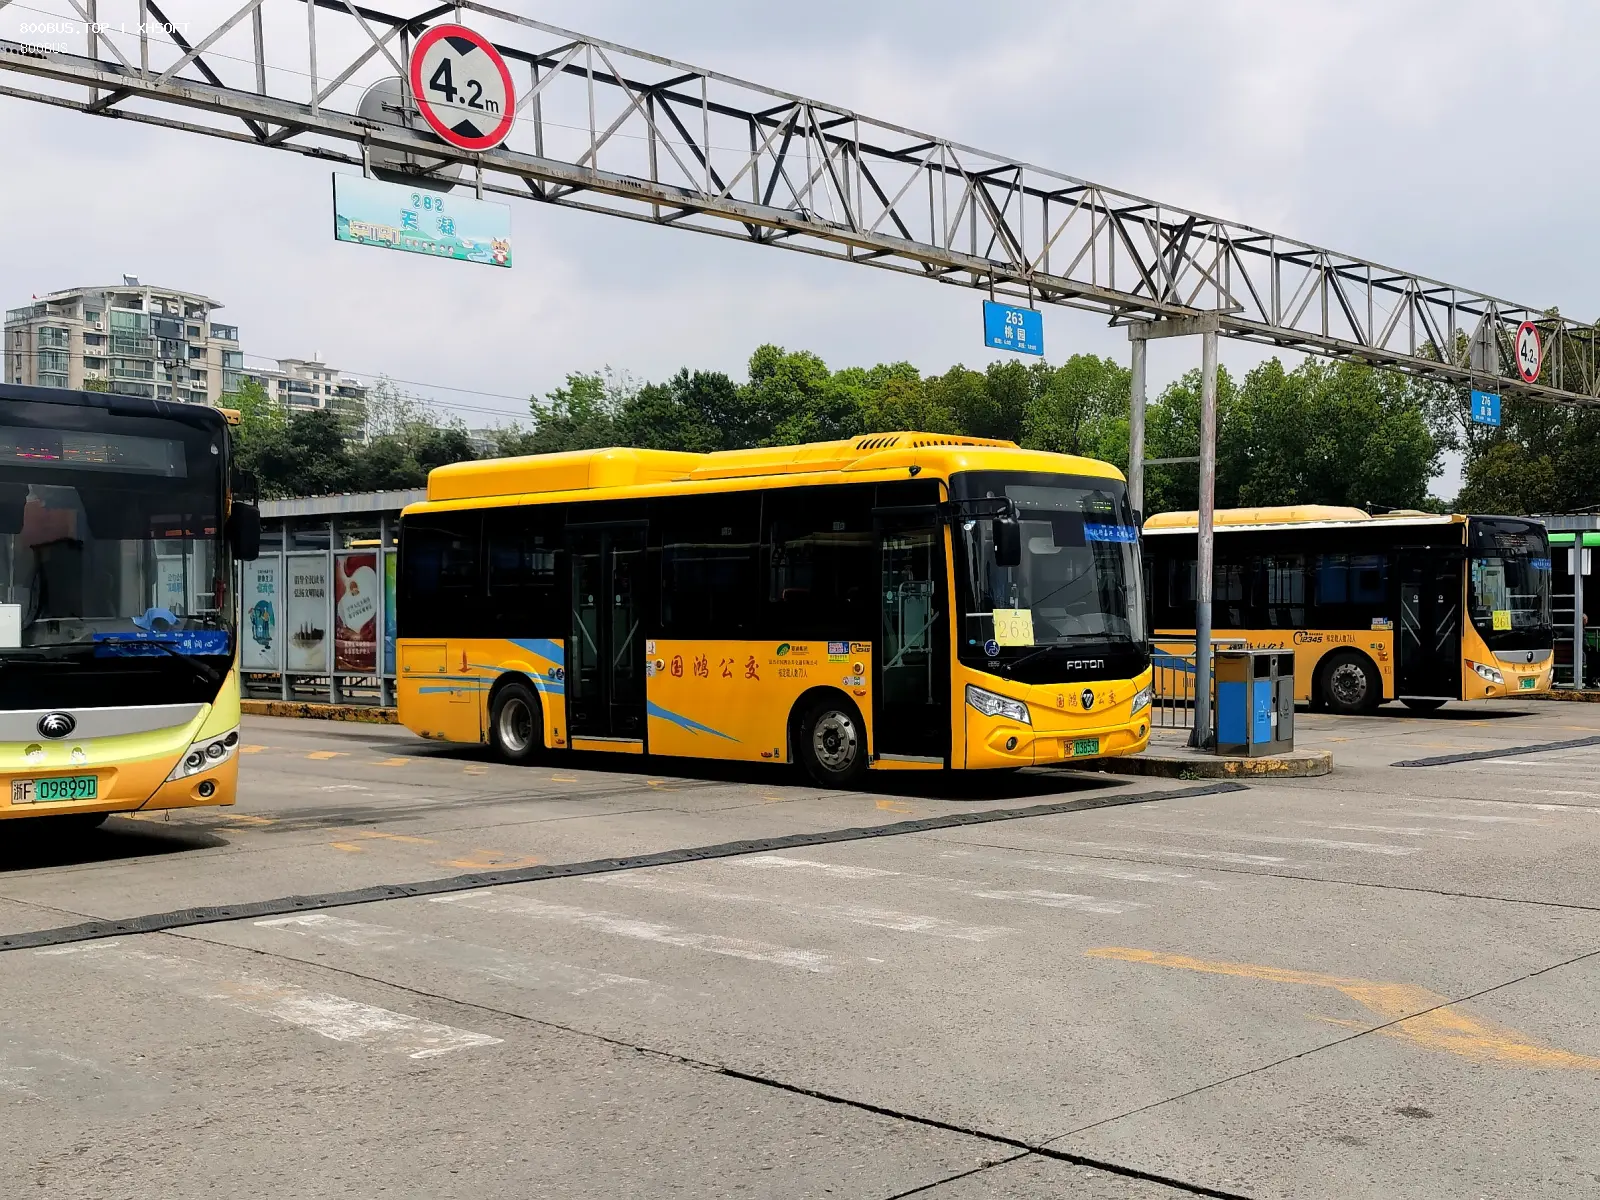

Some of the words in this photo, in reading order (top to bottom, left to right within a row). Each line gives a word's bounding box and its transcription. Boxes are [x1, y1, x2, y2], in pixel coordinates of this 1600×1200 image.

[429, 58, 499, 114] 4.2m
[411, 193, 444, 212] 282
[1005, 310, 1024, 326] 263
[998, 620, 1031, 640] 263
[670, 653, 760, 681] 国鸿公交
[1066, 659, 1105, 670] FOTON
